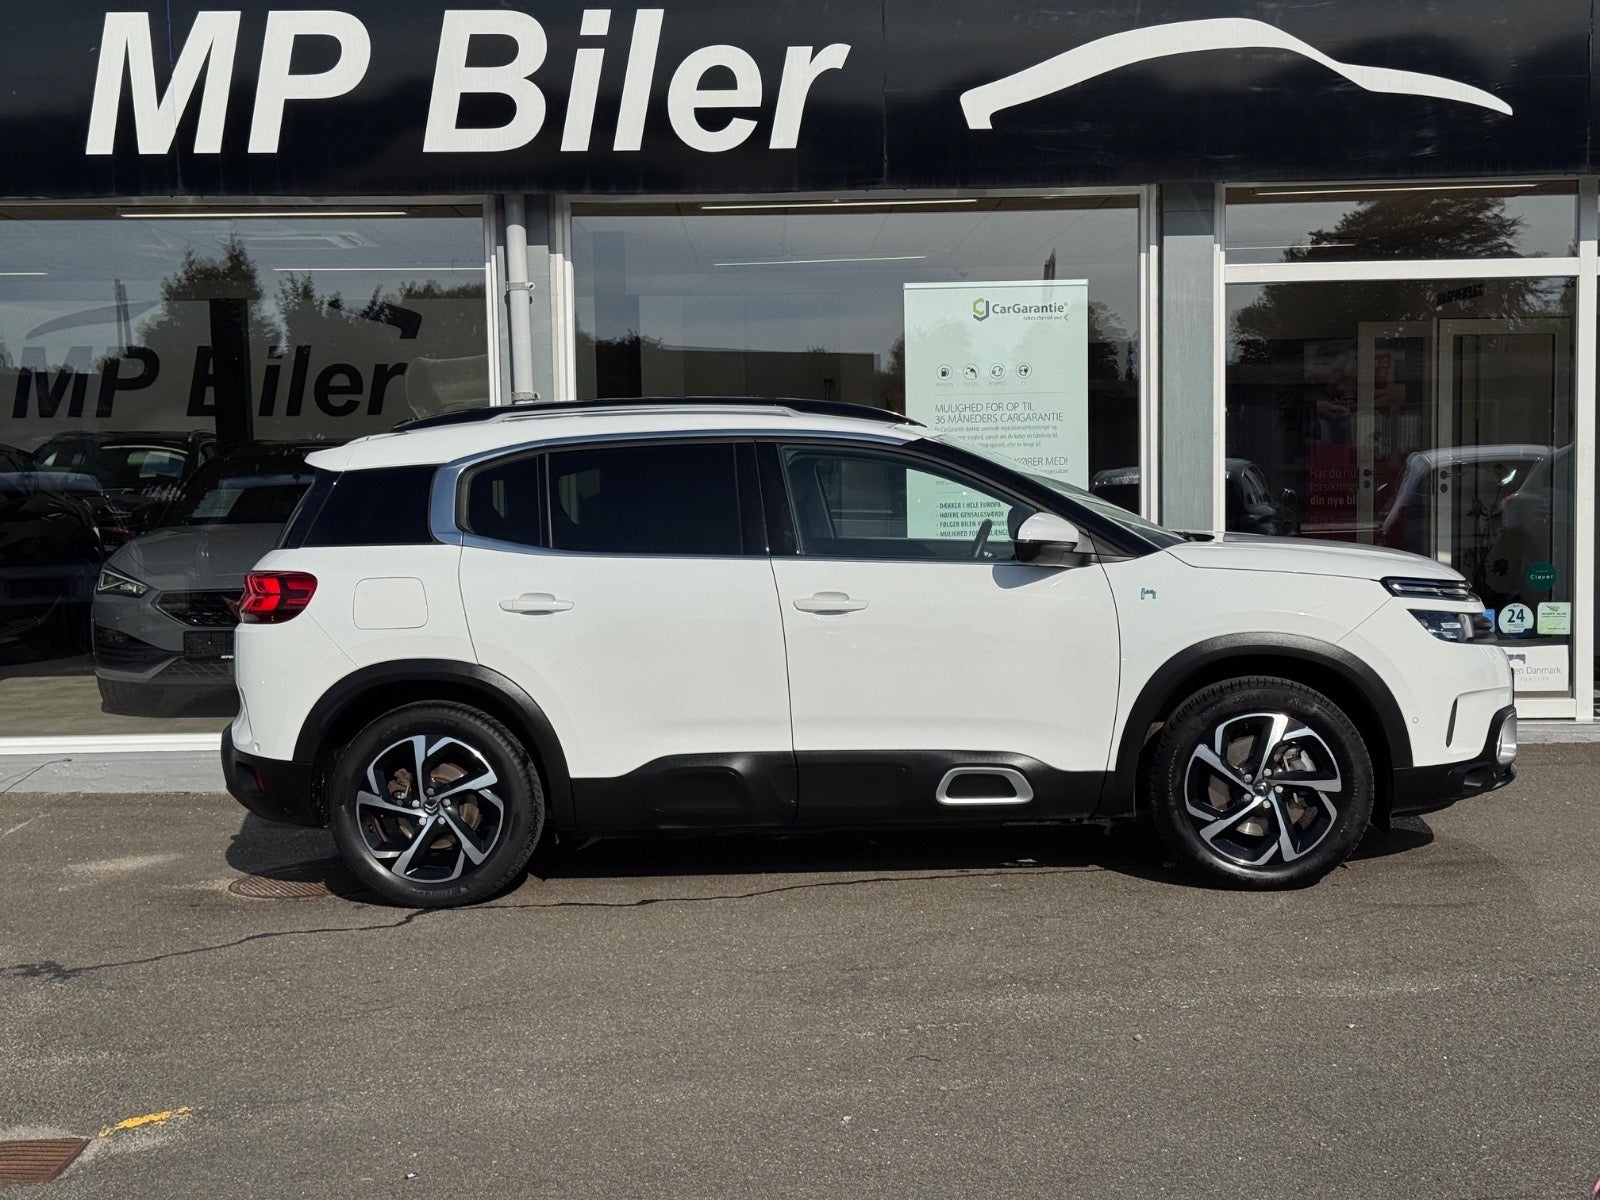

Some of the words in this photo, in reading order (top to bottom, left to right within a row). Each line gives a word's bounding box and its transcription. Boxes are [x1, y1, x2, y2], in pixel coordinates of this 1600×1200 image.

[85, 10, 371, 155] MP
[423, 9, 851, 153] Biler
[992, 302, 1065, 315] CarGarantie
[935, 403, 984, 413] MULIGHED
[986, 402, 1004, 412] FOR
[1006, 402, 1020, 411] OP
[1021, 402, 1034, 411] TIL
[935, 415, 946, 425] 36
[948, 412, 998, 424] MÅNEDERS
[1000, 412, 1064, 422] CARGARANTIE
[1045, 456, 1068, 466] MED!
[1310, 496, 1325, 505] din
[1327, 497, 1344, 507] nye
[1507, 608, 1526, 624] 24
[1526, 666, 1562, 675] Danmark
